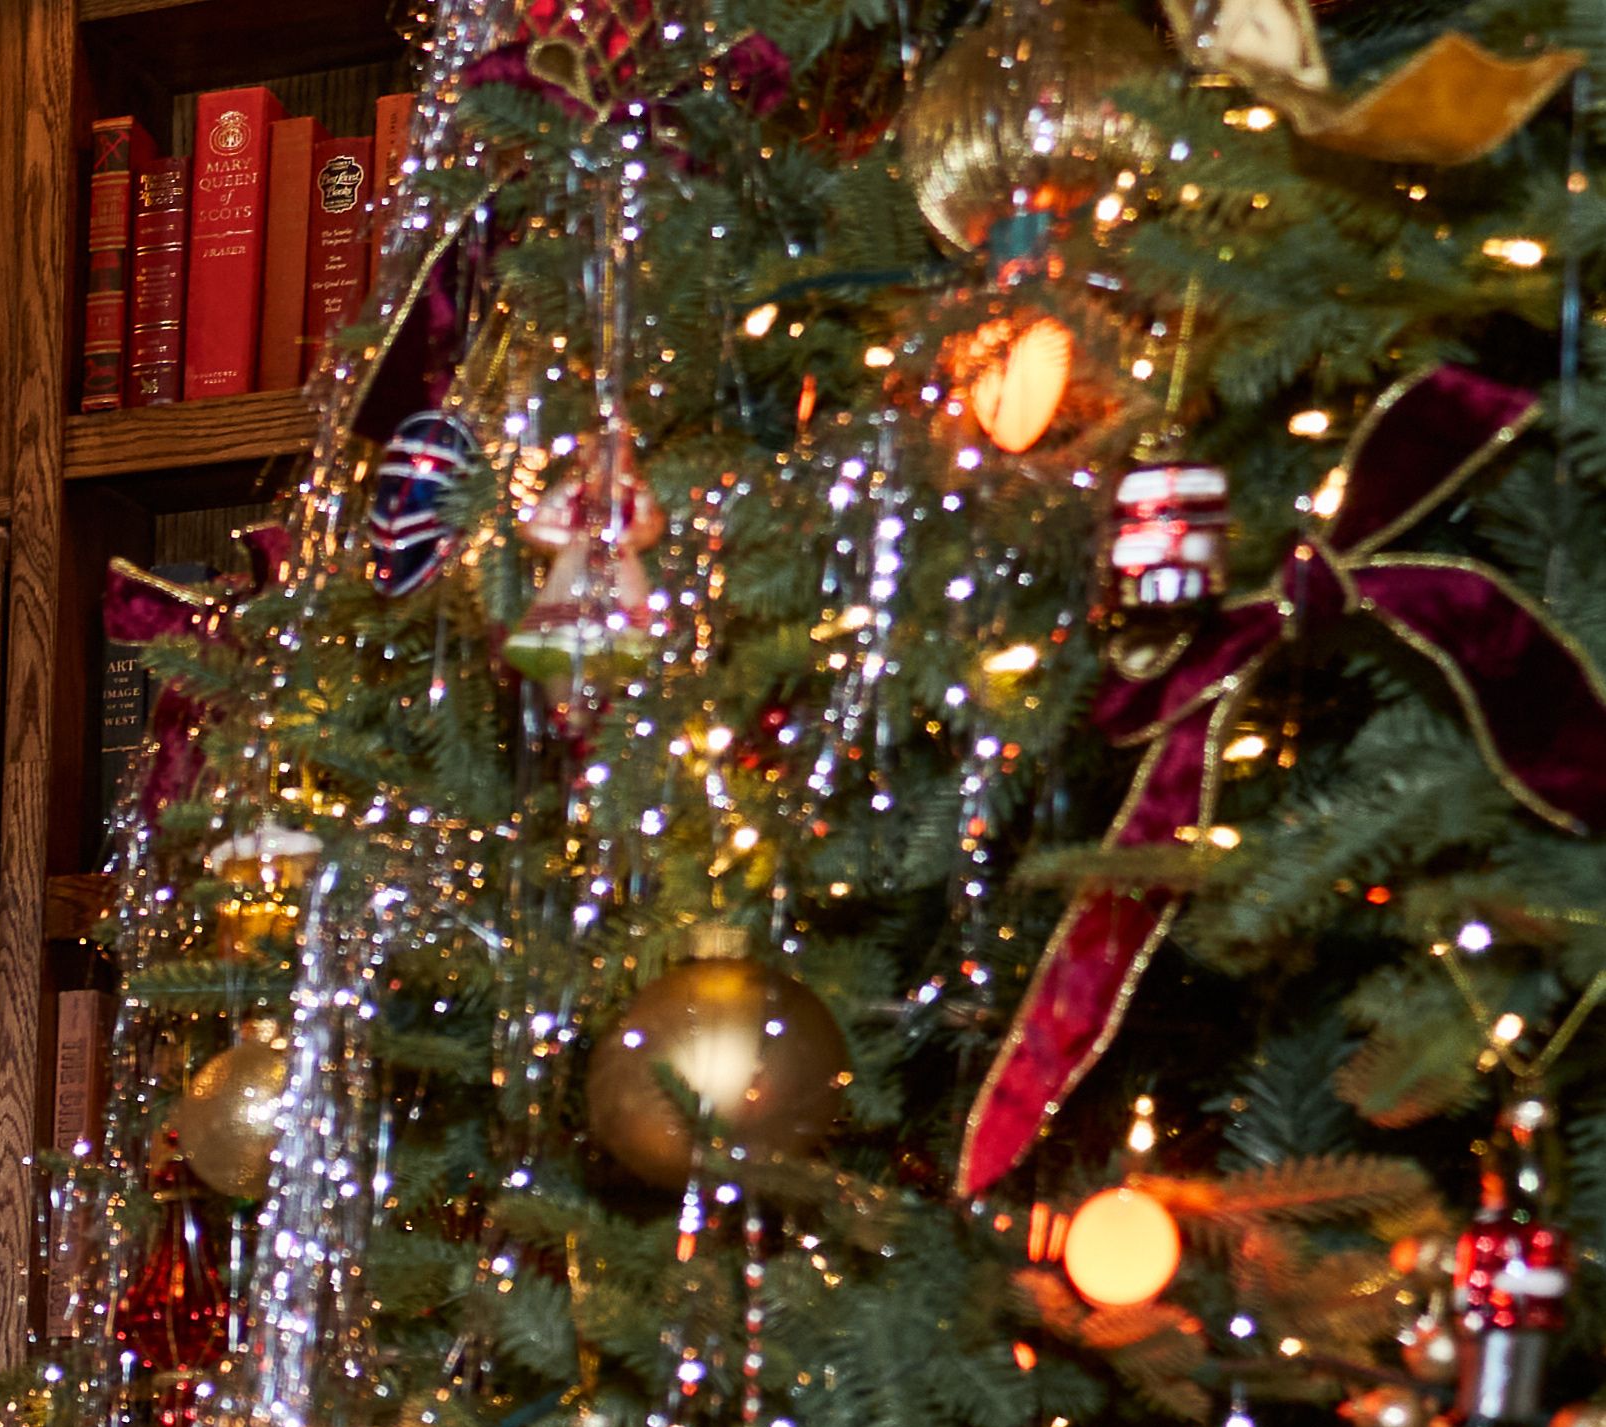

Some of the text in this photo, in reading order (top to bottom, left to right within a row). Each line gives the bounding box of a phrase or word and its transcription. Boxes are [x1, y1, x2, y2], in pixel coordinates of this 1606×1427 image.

[206, 159, 250, 172] MARY
[199, 173, 257, 192] QUEEN
[221, 190, 233, 205] of
[199, 206, 252, 221] SCOTS
